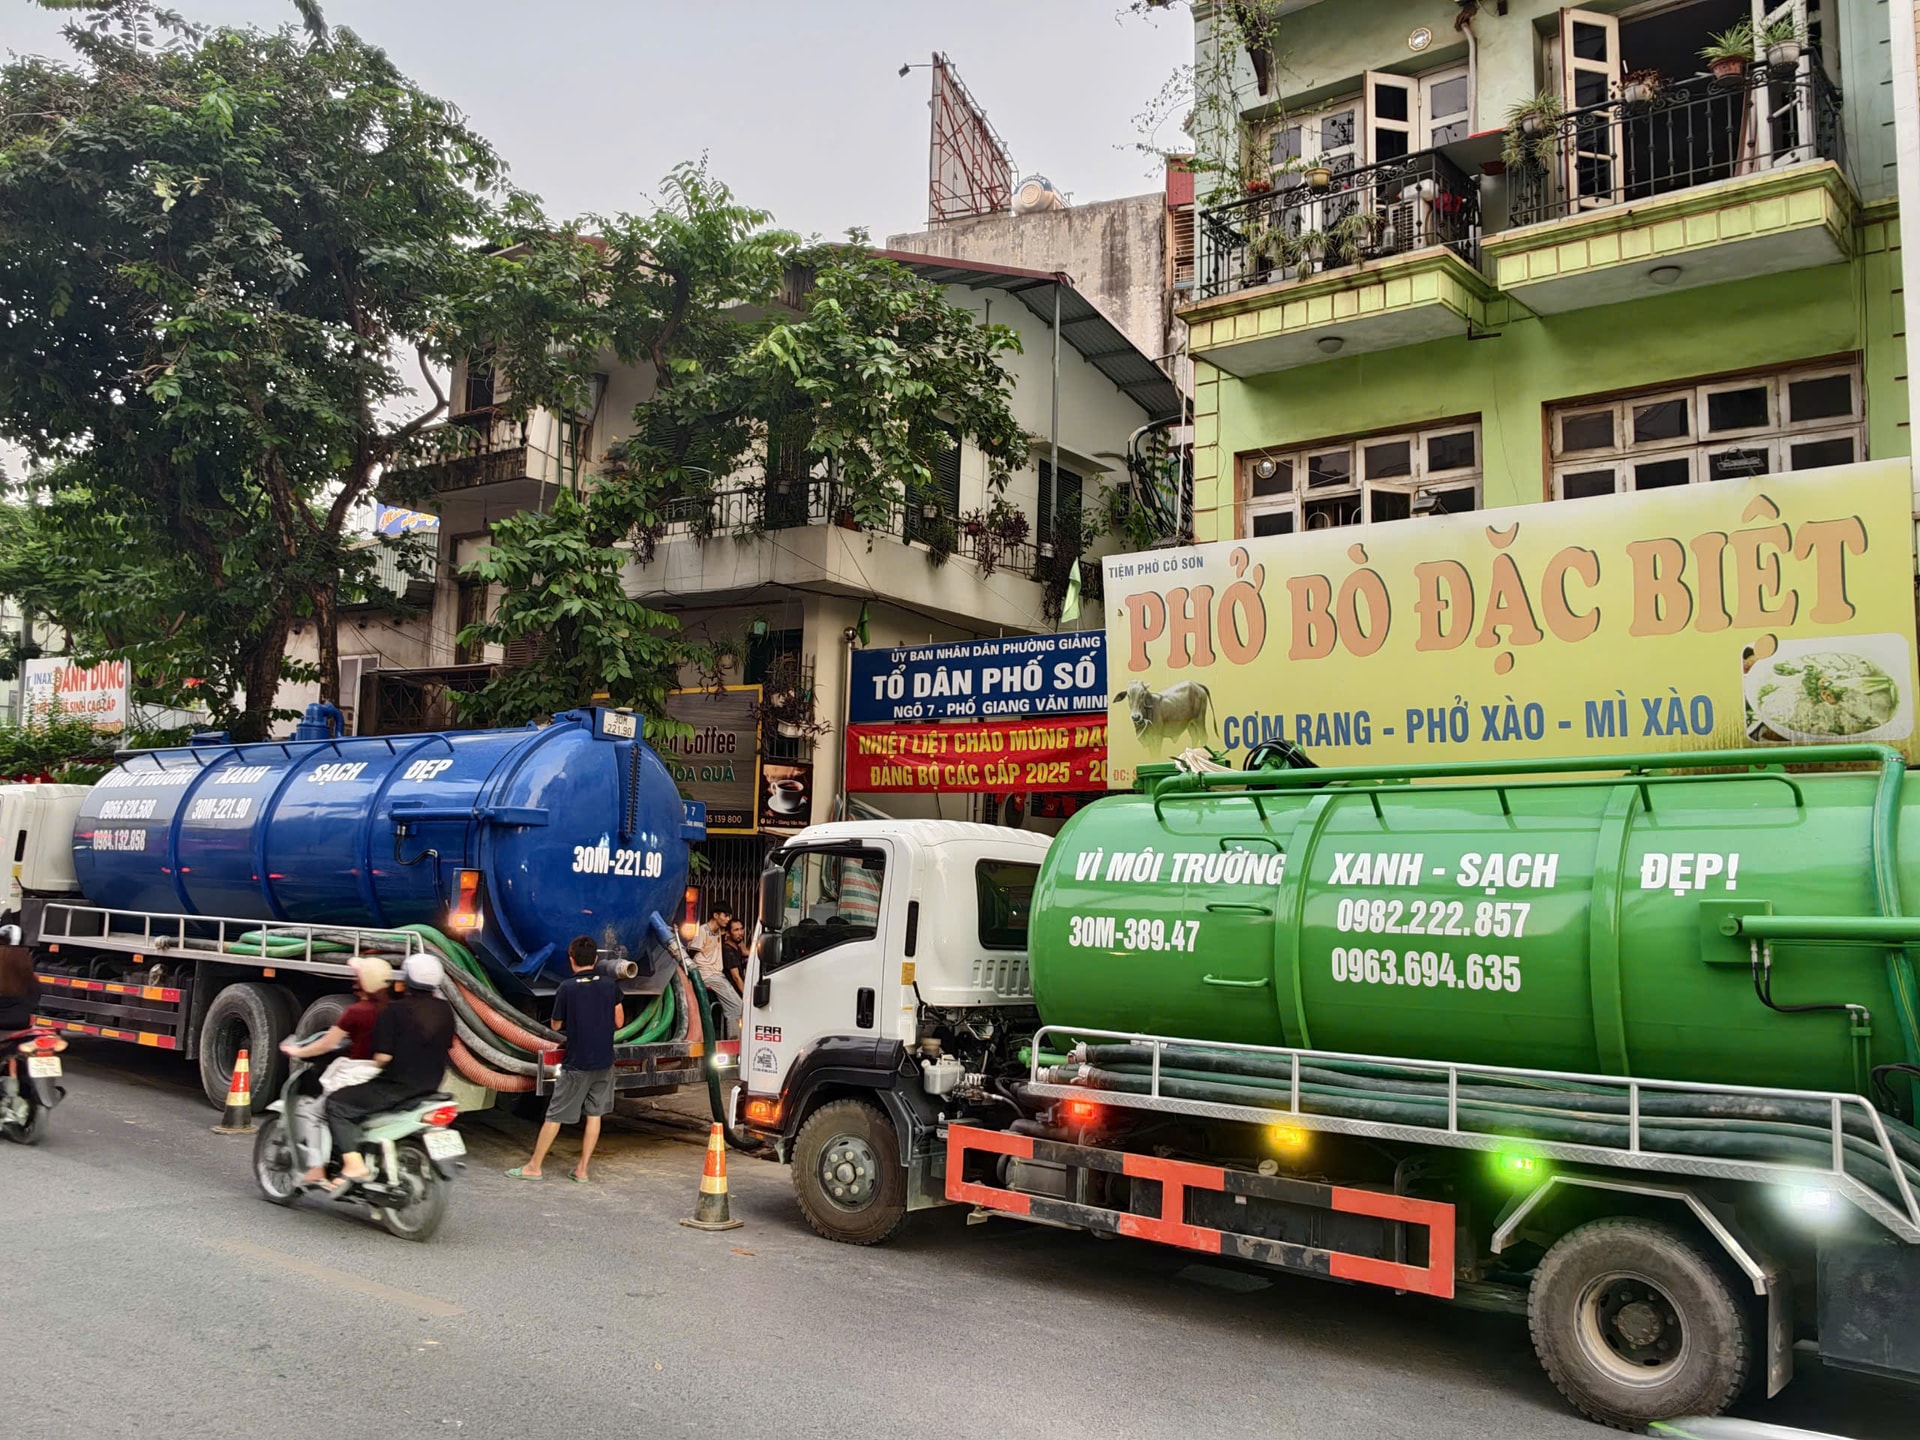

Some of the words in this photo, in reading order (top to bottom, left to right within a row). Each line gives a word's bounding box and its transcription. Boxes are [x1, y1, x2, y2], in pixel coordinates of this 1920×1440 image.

[1108, 563, 1134, 580] TIỆM
[1137, 558, 1160, 575] PHỞ
[1181, 555, 1204, 570] SƠN
[1124, 546, 1267, 672] PHỞ
[1286, 543, 1391, 661] BÒ
[1413, 521, 1601, 675] ĐẶC
[1625, 493, 1869, 660] BIỆT
[891, 648, 906, 663] ỦY
[910, 650, 933, 661] BAN
[937, 645, 970, 659] NHÂN
[973, 642, 999, 656] DÂN
[1002, 639, 1055, 654] PHƯỜNG
[1058, 633, 1101, 650] GIẢNG
[872, 664, 906, 700] TỔ
[913, 666, 972, 698] DÂN
[982, 655, 1044, 694] PHỐ
[1053, 651, 1097, 690] SỐ
[613, 714, 628, 725] 30M
[894, 702, 923, 718] NGÕ
[927, 705, 935, 716] 7
[947, 696, 976, 715] PHỐ
[982, 698, 1030, 714] GIANG
[1035, 694, 1068, 710] VĂN
[1223, 711, 1284, 749] CƠM
[1296, 710, 1371, 747] RANG
[1383, 727, 1394, 735] -
[1406, 695, 1470, 744] PHỞ
[1480, 695, 1544, 742] XÀO
[1557, 721, 1571, 729] -
[1585, 690, 1629, 738] MÌ
[1642, 687, 1714, 737] XÀO
[684, 726, 737, 754] Coffee
[859, 731, 908, 758] NHIỆT
[911, 730, 949, 757] LIỆT
[954, 728, 1006, 754] CHÀO
[1009, 726, 1069, 751] MỪNG
[214, 766, 271, 784] XANH
[308, 762, 368, 787] SẠCH
[402, 759, 454, 784] ĐẸP
[701, 759, 736, 782] QUẢ
[870, 759, 913, 786] ĐẢNG
[918, 761, 940, 790] BỘ
[944, 760, 980, 785] CÁC
[984, 756, 1020, 785] CẤP
[1025, 761, 1071, 784] 2025
[192, 798, 252, 820] 30M-221.90
[691, 806, 696, 816] 7
[572, 846, 662, 878] 30M-221.90
[1075, 847, 1103, 881] VÌ
[1105, 846, 1164, 882] MÔI
[1170, 845, 1287, 885] TRƯỜNG
[1328, 852, 1424, 886] XANH
[1432, 867, 1446, 876] -
[1456, 853, 1559, 896] SẠCH
[1639, 853, 1740, 897] ĐẸP!
[1069, 915, 1200, 952] 30M-389.47
[1336, 898, 1531, 939] 0982.222.857
[1331, 947, 1521, 992] 0963.694.635
[755, 1033, 782, 1042] 650
